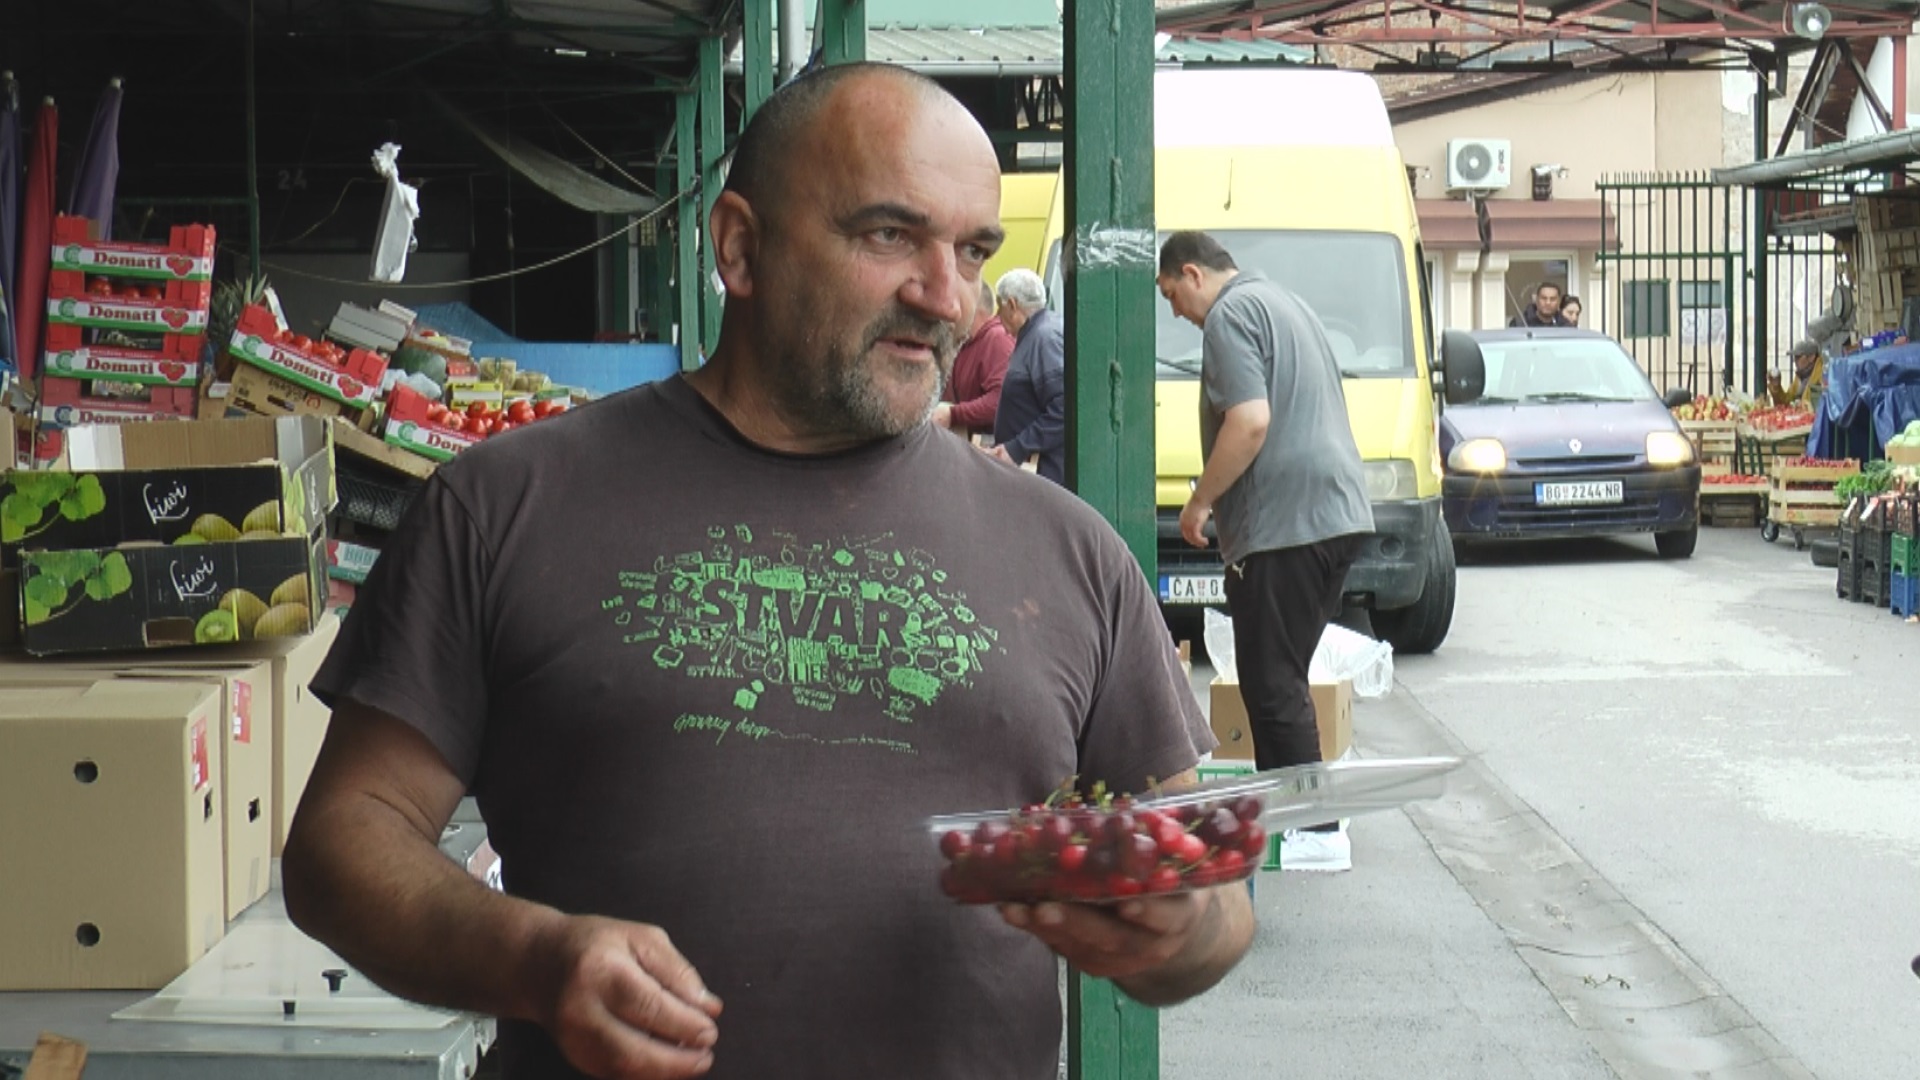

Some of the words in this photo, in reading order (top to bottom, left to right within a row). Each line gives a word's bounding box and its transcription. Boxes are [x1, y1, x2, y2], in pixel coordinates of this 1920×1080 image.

[278, 169, 307, 191] 24
[94, 251, 161, 270] Domati
[88, 305, 156, 323] Domati
[86, 356, 154, 375] Domati
[269, 348, 334, 385] Domati
[702, 578, 909, 649] STVAR
